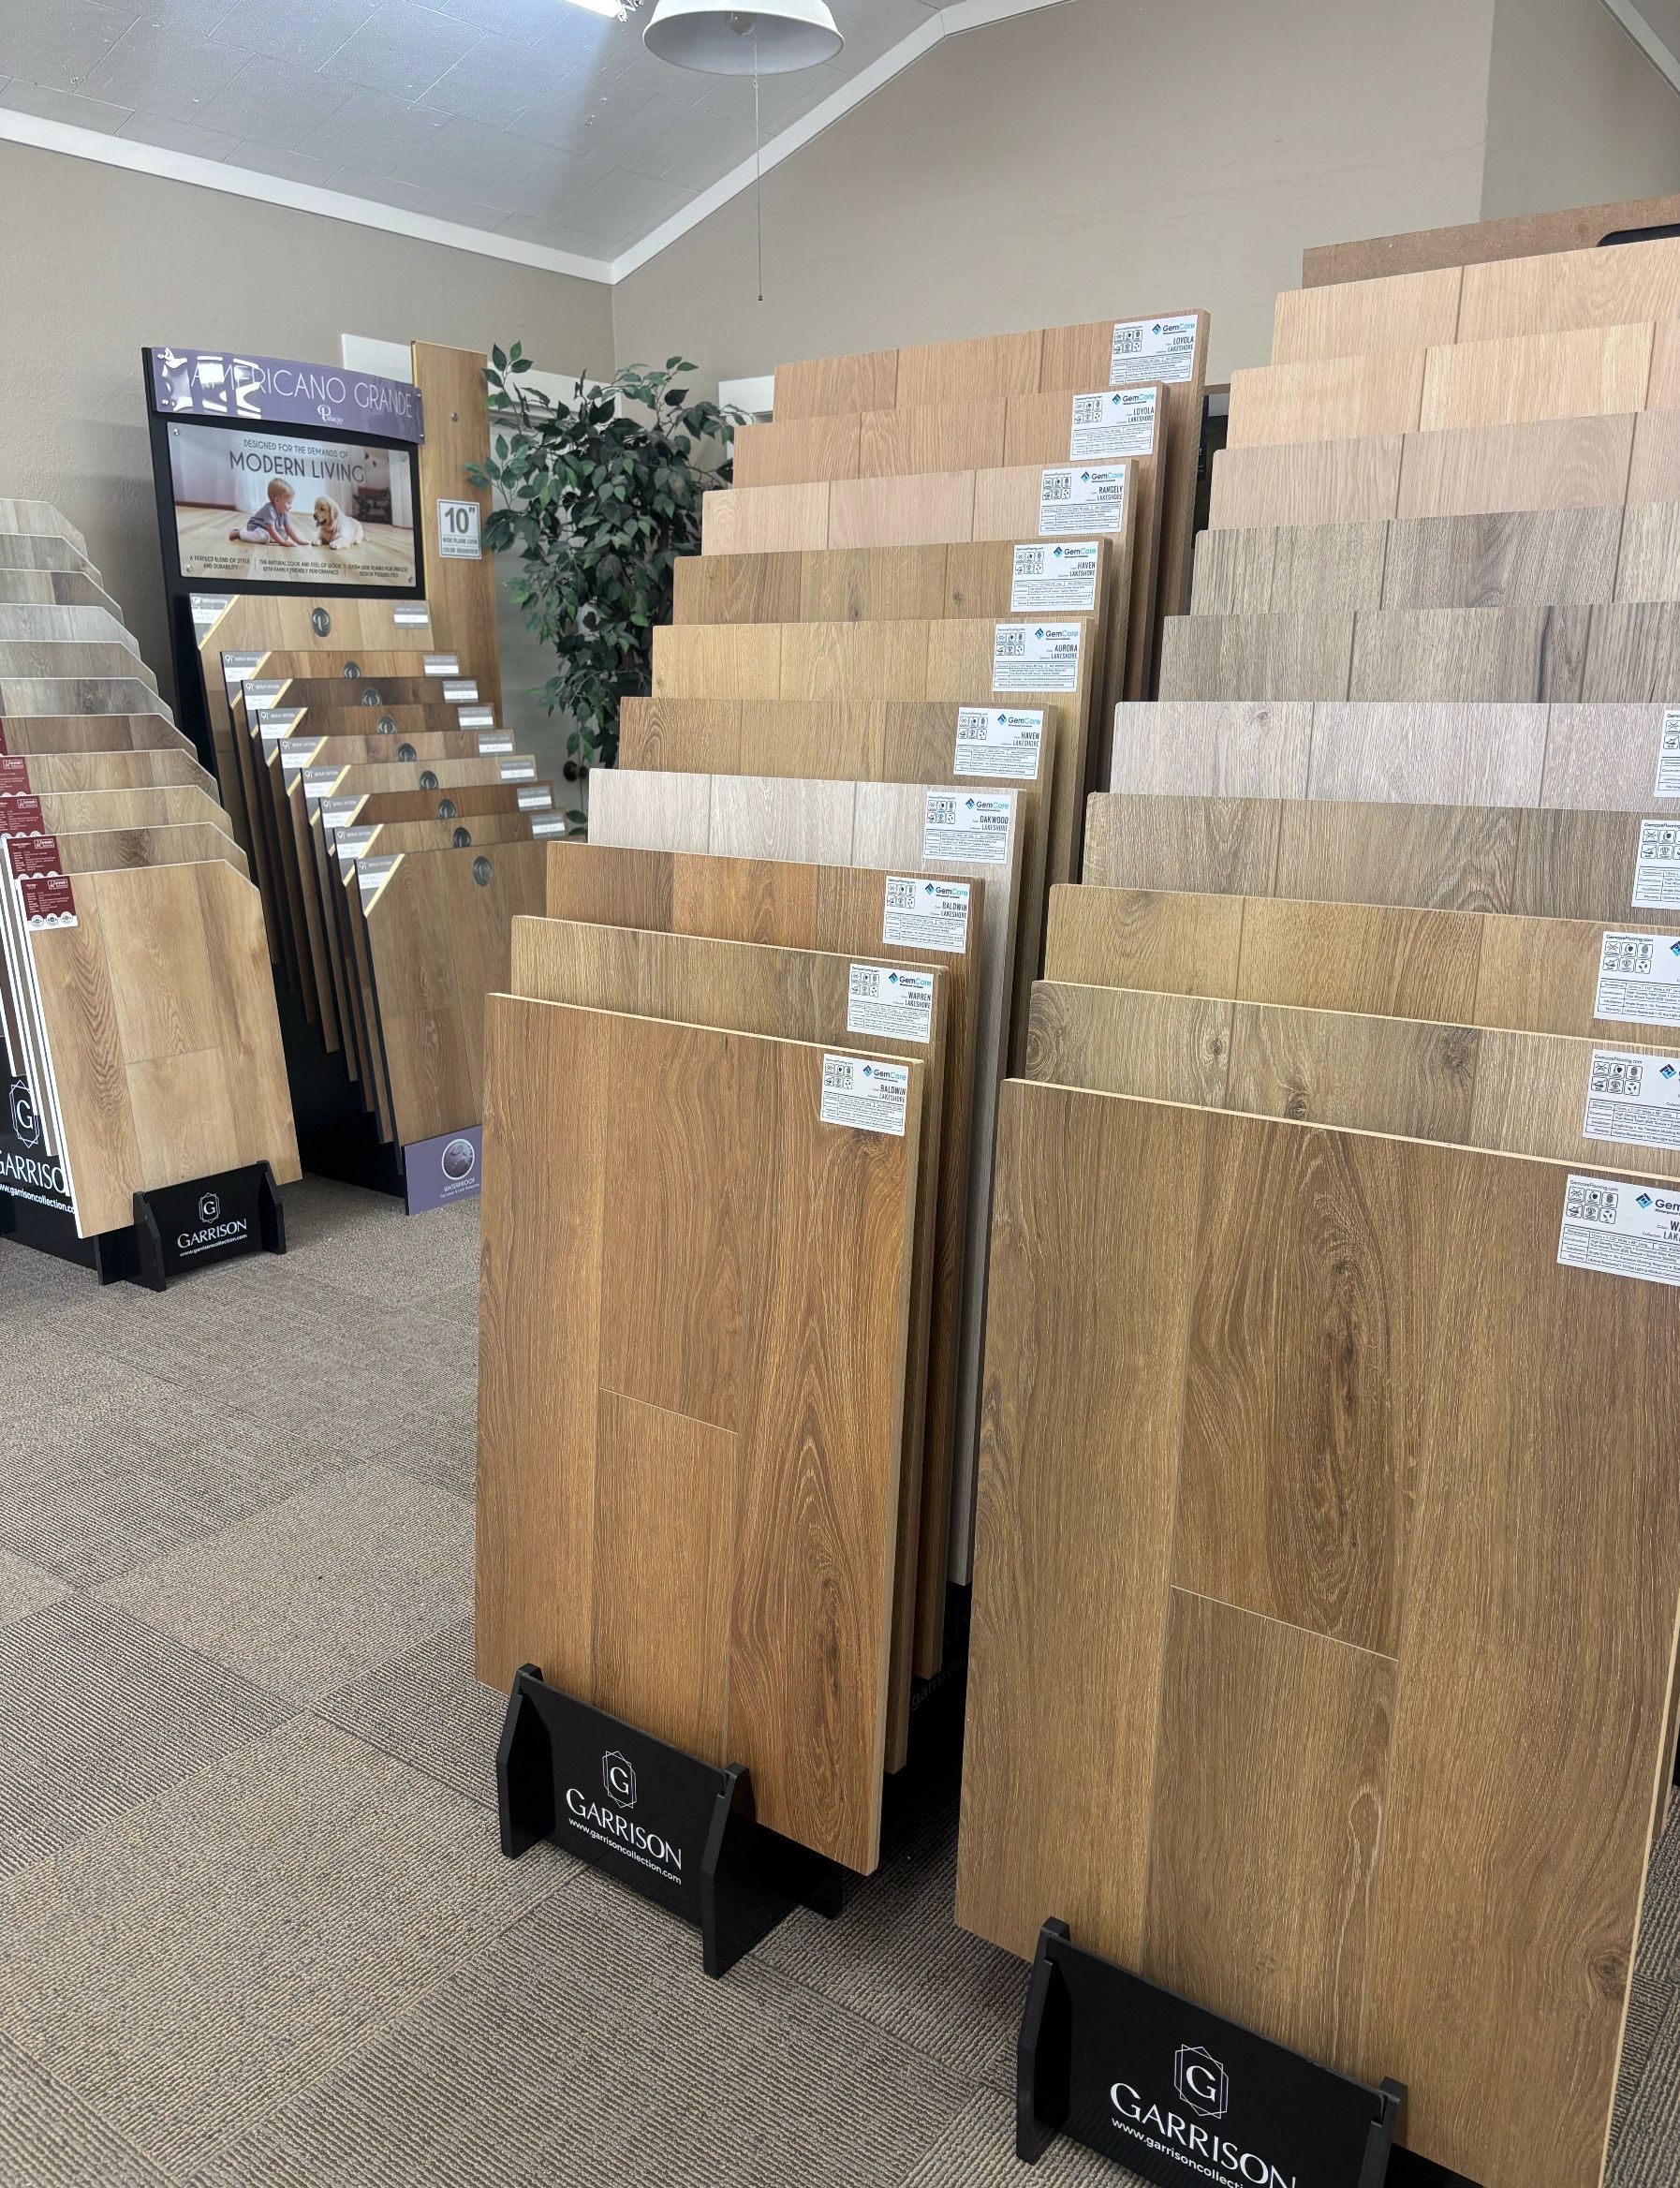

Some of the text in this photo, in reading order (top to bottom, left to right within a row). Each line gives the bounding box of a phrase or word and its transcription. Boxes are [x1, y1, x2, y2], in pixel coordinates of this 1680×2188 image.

[1163, 322, 1195, 332] GemCore
[1172, 335, 1194, 346] LOYOLA
[354, 382, 413, 418] GRANDE
[1123, 393, 1155, 403] GemCore
[1133, 407, 1155, 416] LOYOLA
[243, 439, 277, 451] DESIGNED
[294, 446, 307, 454] THE
[307, 447, 338, 458] DEMANDS
[339, 451, 348, 459] OF
[229, 450, 364, 482] MODERN LIVING
[445, 506, 476, 534] 10"
[1008, 717, 1041, 725] GemCore
[1021, 732, 1039, 740] HAVEN
[976, 801, 1009, 809] GemCore
[980, 815, 1009, 824] OAKWOOD
[936, 886, 968, 896] GemCore
[942, 901, 967, 911] BALDWIN
[899, 976, 931, 986] GemCore
[908, 991, 931, 1001] WARREN
[874, 1069, 906, 1081] GemCore
[880, 1084, 906, 1096] BALDWIN
[16, 1100, 34, 1130] G
[444, 1176, 474, 1191] WATERPROOF
[203, 1201, 215, 1215] G
[1671, 1220, 1680, 1232] W
[177, 1218, 247, 1249] GARRISON
[1663, 1231, 1680, 1242] LAK
[180, 1234, 247, 1257] www.garrisoncollection.com
[610, 1767, 629, 1795] G
[566, 1788, 682, 1870] GARRISON
[568, 1817, 682, 1885] www.garrisoncollection.com
[1186, 2064, 1216, 2103] G
[1111, 2082, 1296, 2188] GARRISON
